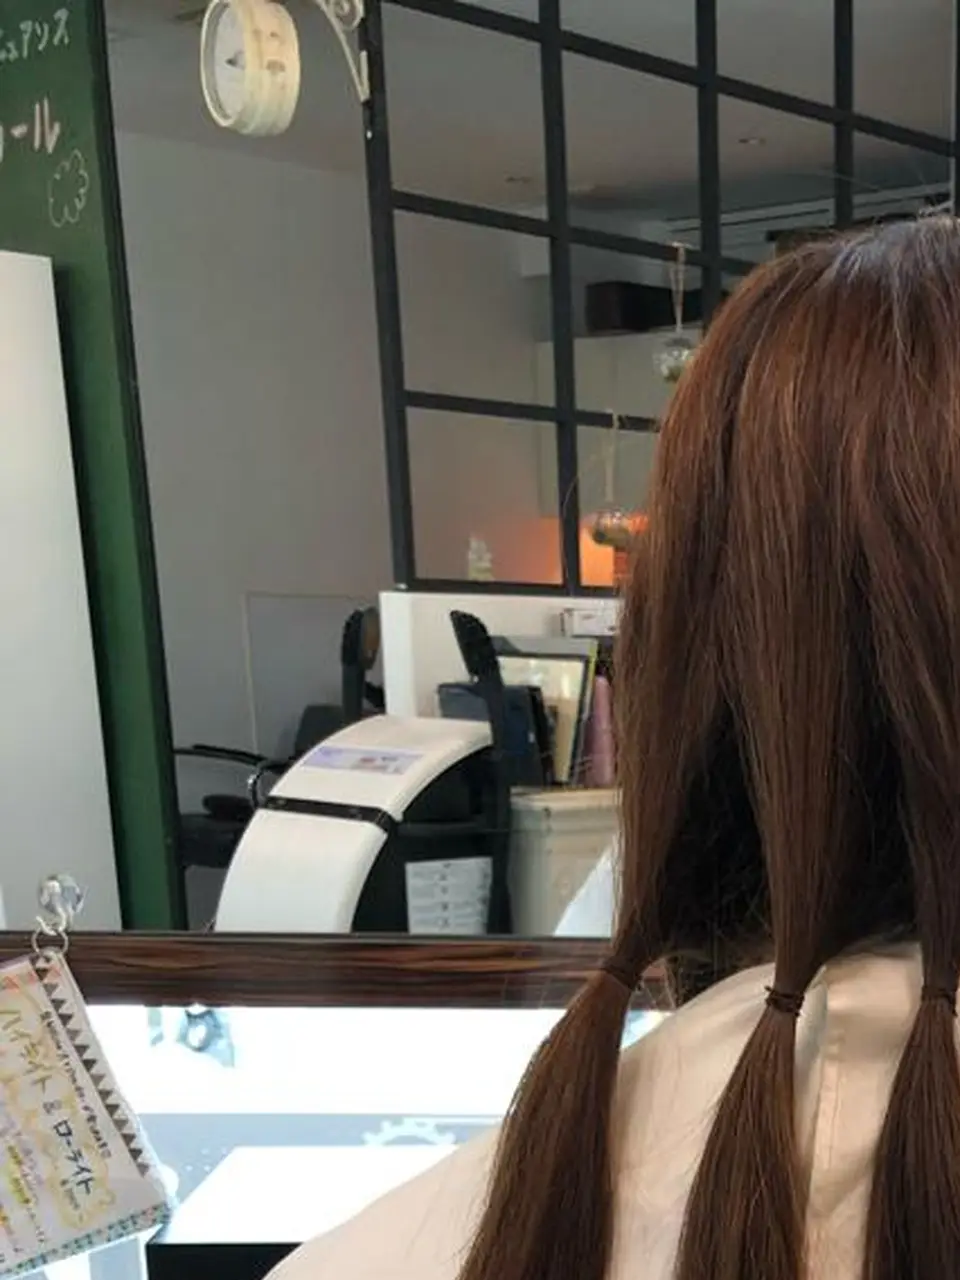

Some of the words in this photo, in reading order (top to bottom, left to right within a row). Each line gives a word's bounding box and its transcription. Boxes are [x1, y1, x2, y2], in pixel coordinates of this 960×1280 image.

[0, 97, 61, 163] ール
[53, 1119, 95, 1196] ローライト
